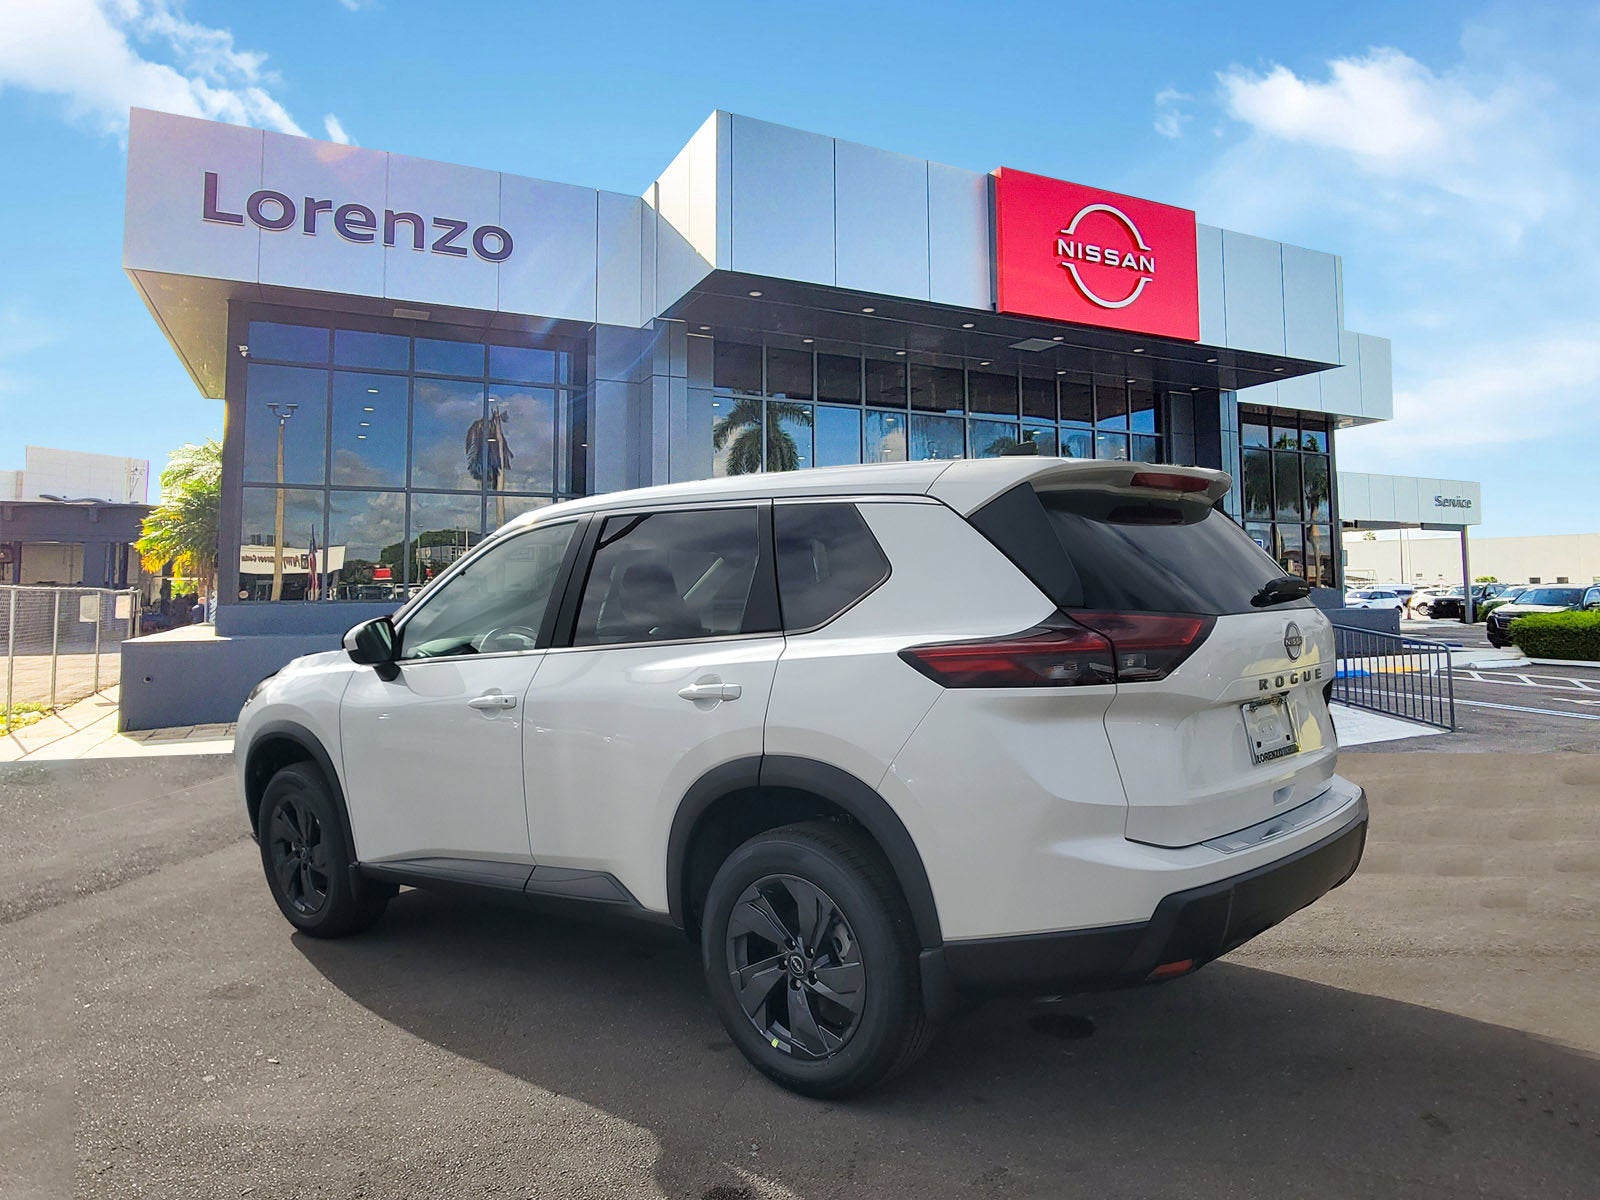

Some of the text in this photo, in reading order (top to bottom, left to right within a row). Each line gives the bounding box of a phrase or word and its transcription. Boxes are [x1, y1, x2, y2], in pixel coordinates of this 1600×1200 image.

[203, 171, 514, 262] Lorenzo
[1057, 238, 1155, 273] NISSAN
[1434, 495, 1472, 509] Service
[1259, 668, 1321, 690] ROGUE
